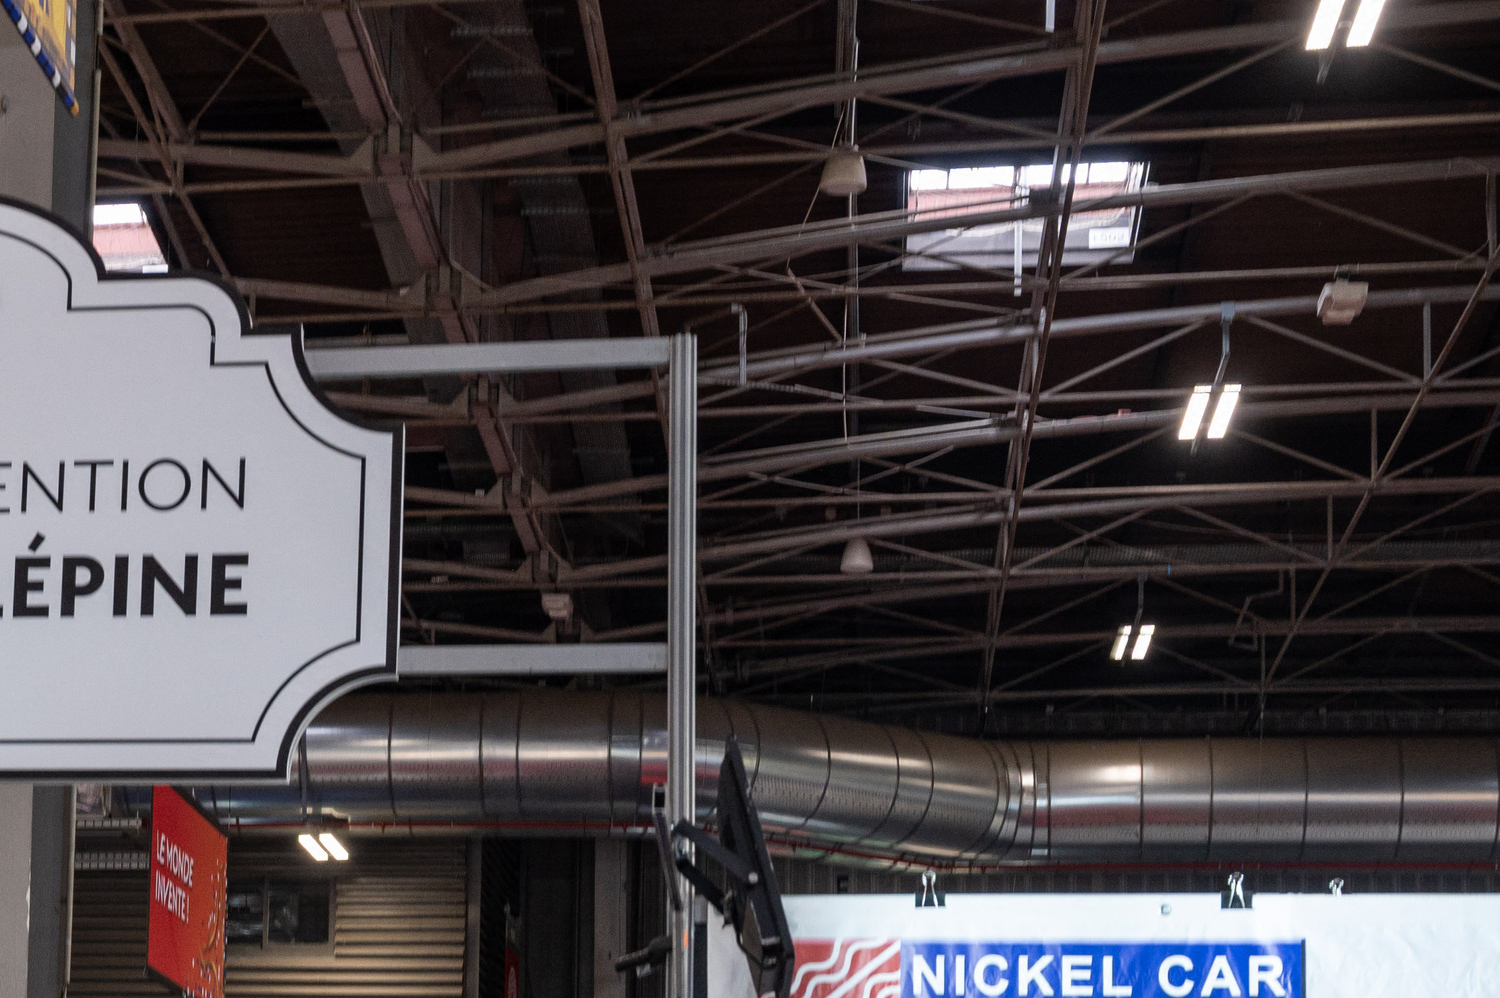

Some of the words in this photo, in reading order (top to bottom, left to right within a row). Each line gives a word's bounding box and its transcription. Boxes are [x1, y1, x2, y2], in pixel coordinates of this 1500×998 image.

[156, 829, 166, 866] LE
[166, 835, 194, 889] MONDE
[155, 869, 186, 922] INVENTE
[911, 954, 1133, 998] NICKEL
[1158, 954, 1286, 998] CAR
